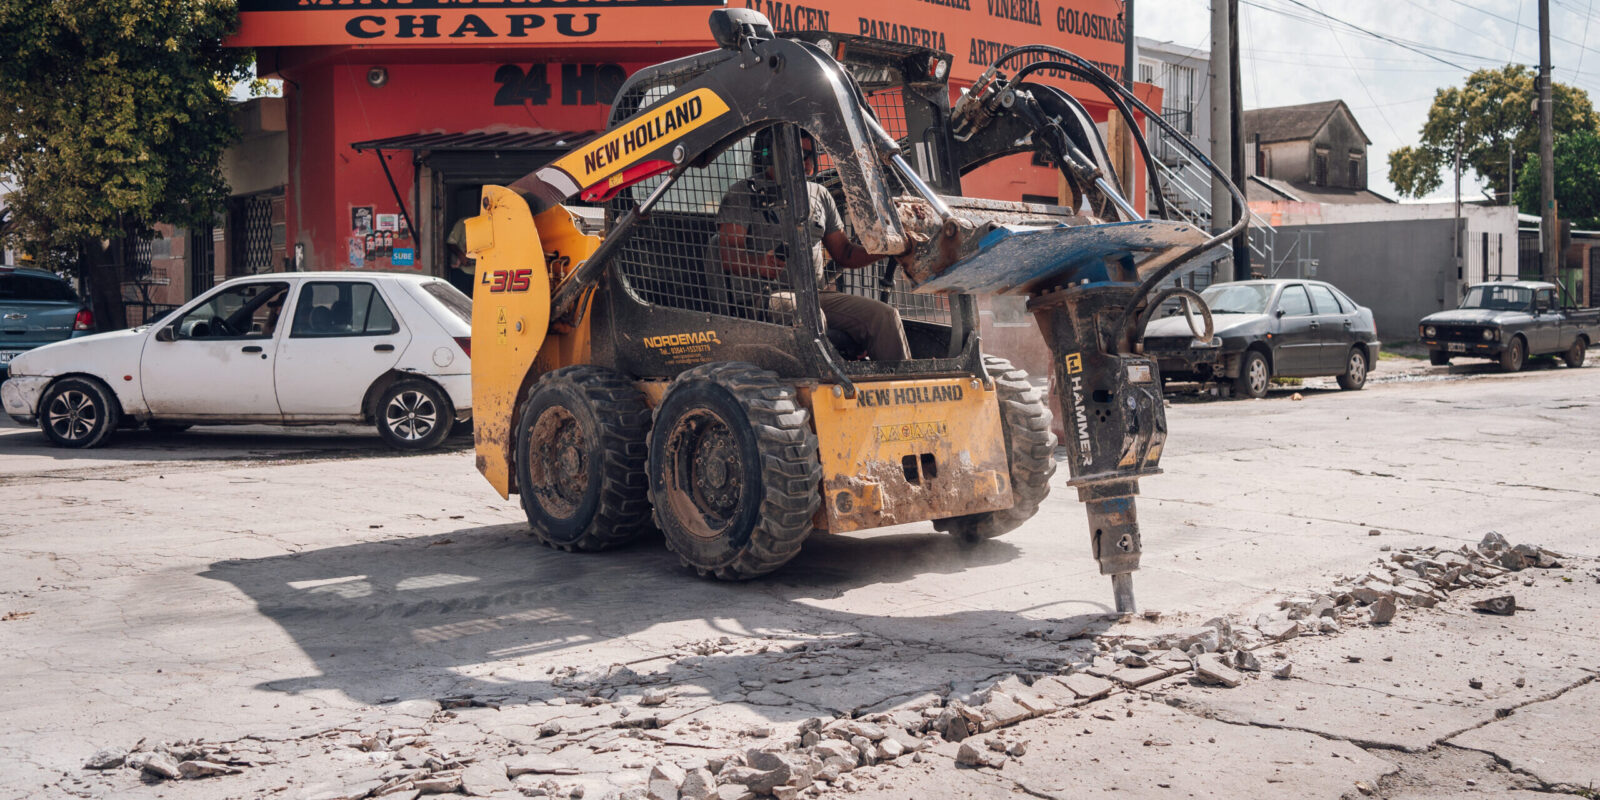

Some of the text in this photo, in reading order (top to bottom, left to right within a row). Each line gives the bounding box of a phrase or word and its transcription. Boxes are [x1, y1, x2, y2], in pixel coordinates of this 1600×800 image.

[345, 13, 601, 38] CHAPU
[987, 0, 1042, 26] VINERIA
[1056, 6, 1125, 44] GOLOSINAS
[858, 17, 946, 53] PANADERIA
[494, 63, 551, 106] 24
[584, 95, 703, 175] NEW HOLLAND
[393, 252, 412, 260] SUBE
[643, 330, 721, 348] NORDEMAQ
[856, 384, 964, 407] NEW HOLLAND
[1071, 376, 1093, 467] HAMMER
